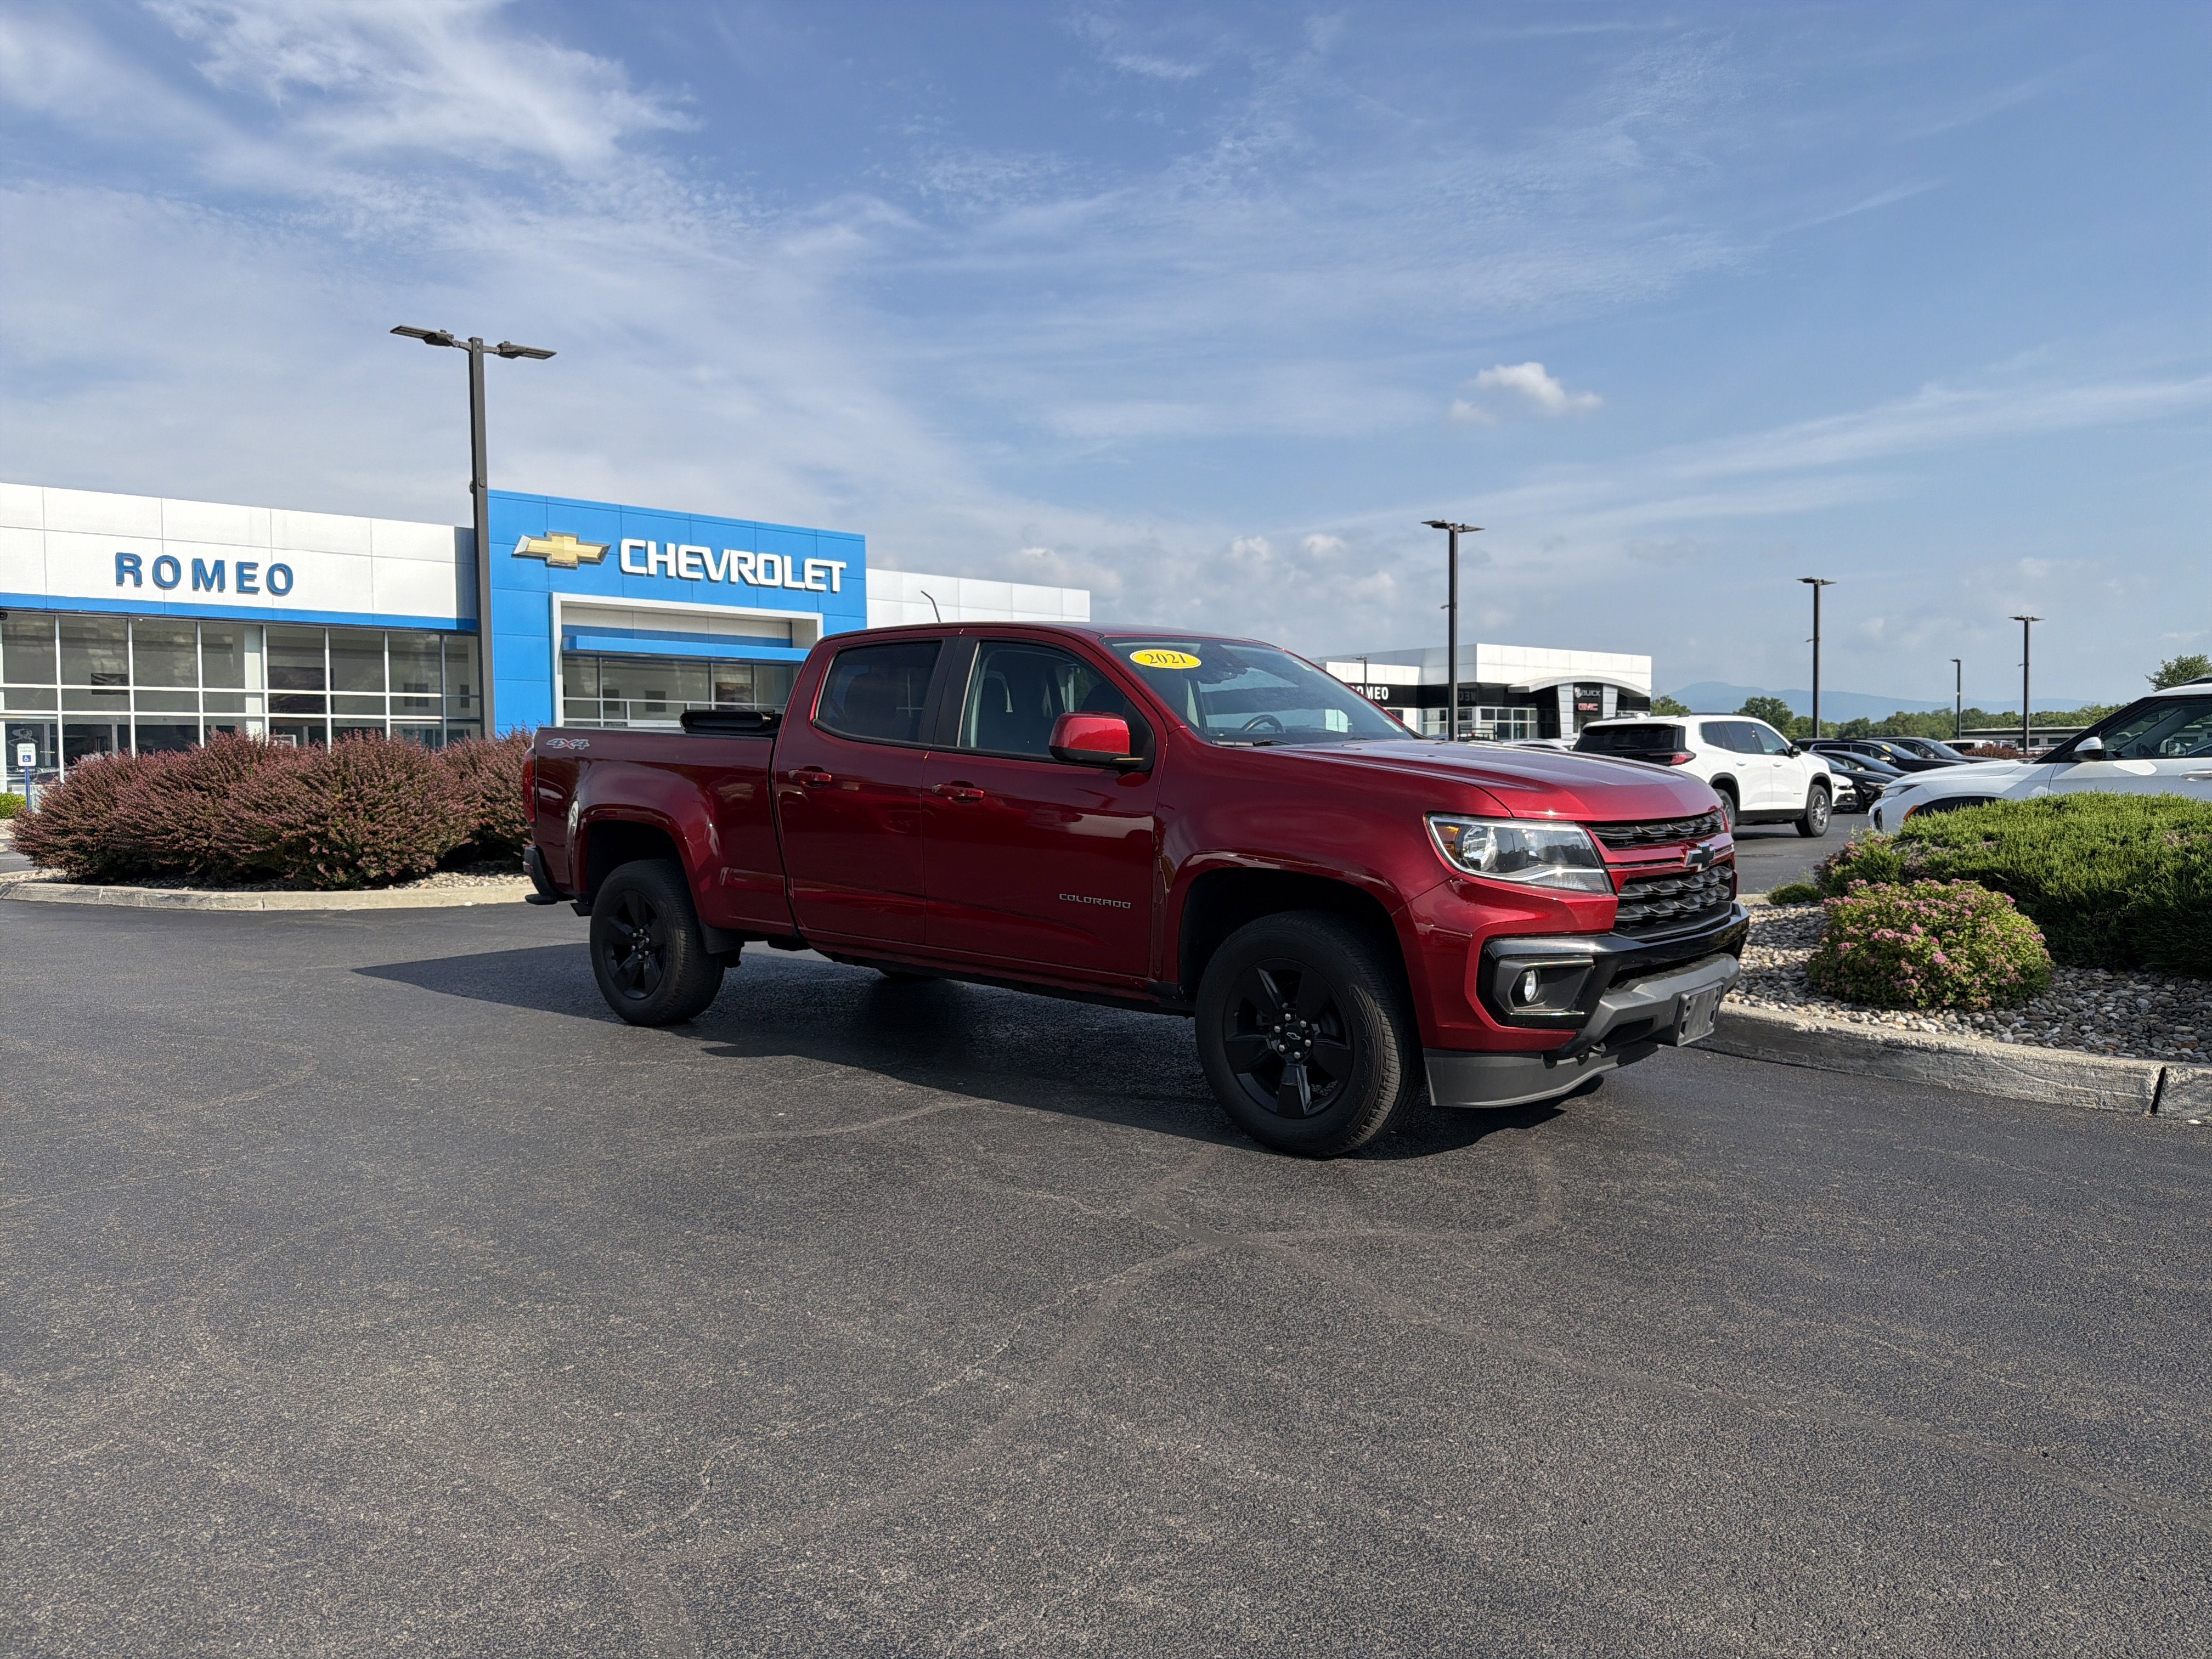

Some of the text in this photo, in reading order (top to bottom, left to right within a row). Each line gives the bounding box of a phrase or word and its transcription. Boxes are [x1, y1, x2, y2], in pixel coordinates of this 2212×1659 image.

[620, 538, 847, 592] CHEVROLET
[115, 552, 293, 597] ROMEO
[1144, 653, 1187, 664] 2021
[1351, 686, 1389, 700] OMEO
[1578, 703, 1598, 711] GMC
[1059, 893, 1131, 909] COLORADO
